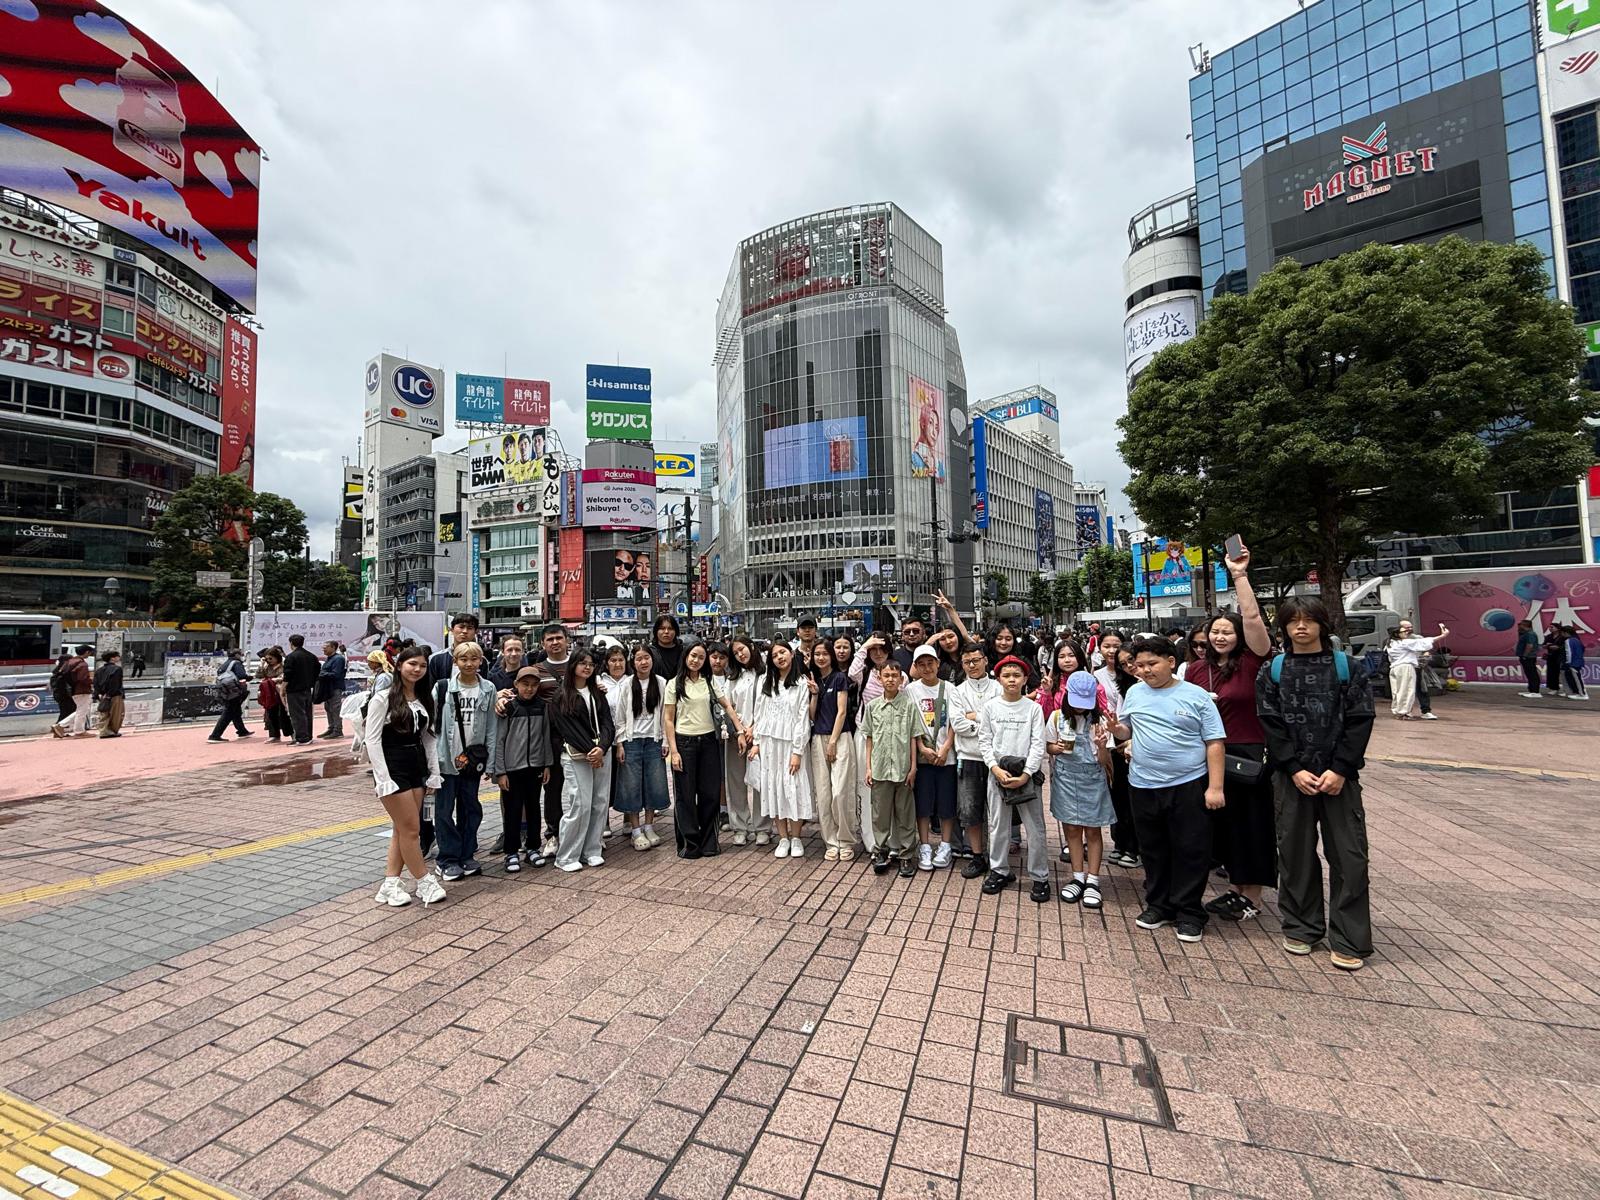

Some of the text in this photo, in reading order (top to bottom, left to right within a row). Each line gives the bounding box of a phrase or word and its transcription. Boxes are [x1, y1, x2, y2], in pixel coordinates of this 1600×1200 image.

[128, 124, 177, 163] Yakult
[1303, 146, 1438, 212] MAGNET
[63, 167, 207, 261] Yakult
[0, 317, 44, 332] ストラン
[48, 324, 113, 350] ガスト
[137, 319, 204, 363] コンタクト
[0, 338, 86, 369] ガスト
[101, 364, 127, 374] ガスト
[188, 371, 217, 392] ガスト
[397, 372, 433, 399] UC
[587, 378, 650, 392] Hisamitsu
[995, 402, 1032, 419] SEIBU
[420, 416, 439, 427] VISA
[590, 411, 648, 429] サロンパス
[471, 455, 505, 473] 世界へ
[656, 460, 690, 470] KEA
[471, 469, 505, 487] DMM
[543, 453, 560, 514] もんじゃ
[604, 470, 635, 479] Rakuten
[586, 505, 620, 513] Shibuya!
[762, 588, 828, 599] STARBUCKS
[593, 608, 637, 619] 大盛堂書
[1477, 665, 1547, 678] MONY
